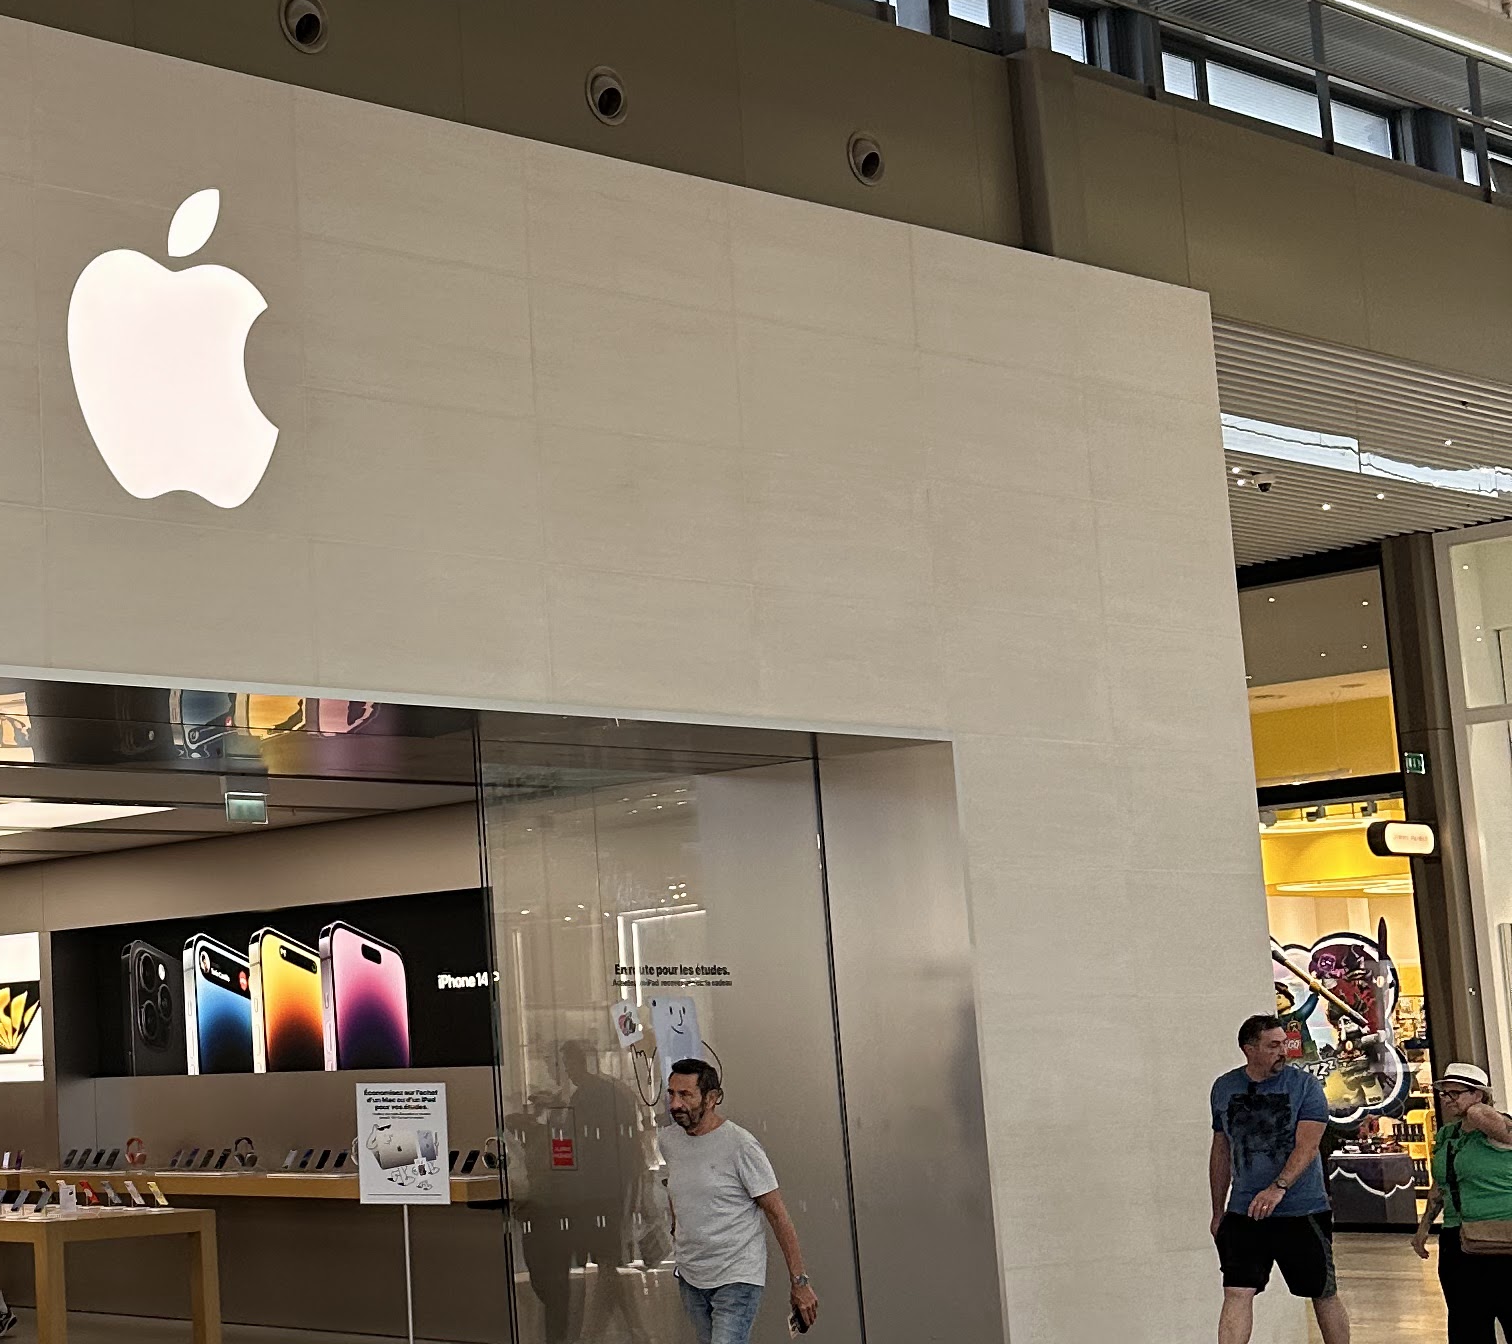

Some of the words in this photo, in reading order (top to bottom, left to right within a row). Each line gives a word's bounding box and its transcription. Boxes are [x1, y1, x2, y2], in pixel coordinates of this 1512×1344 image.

[656, 965, 679, 977] pour
[679, 964, 694, 975] les
[695, 964, 730, 975] études.
[437, 974, 476, 989] iPhone
[475, 971, 489, 987] 14
